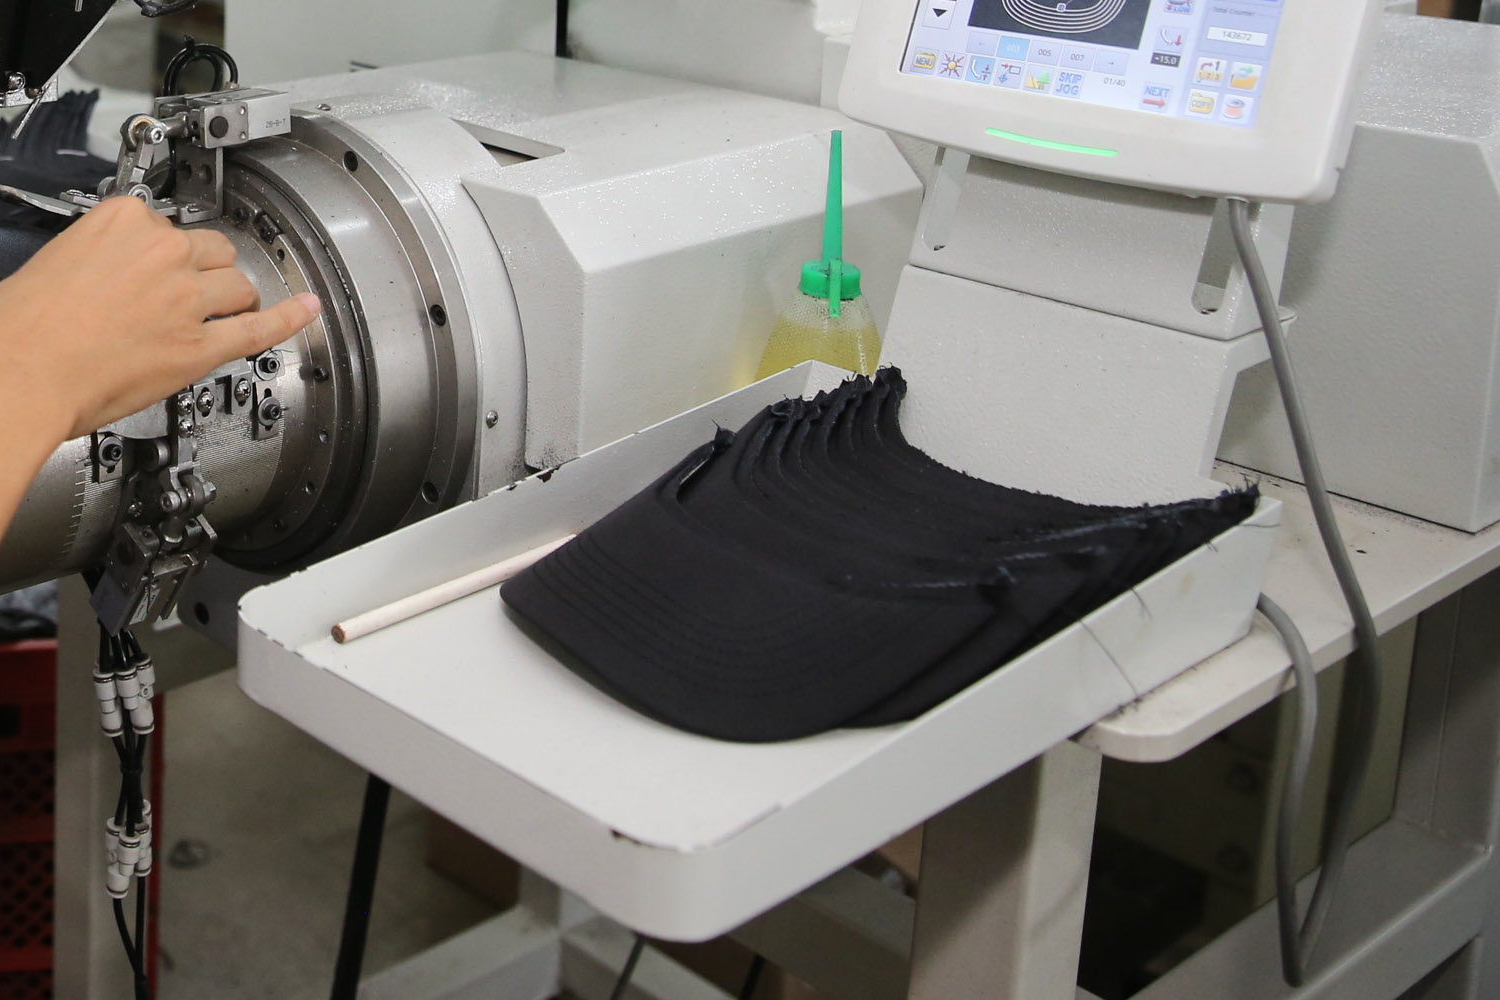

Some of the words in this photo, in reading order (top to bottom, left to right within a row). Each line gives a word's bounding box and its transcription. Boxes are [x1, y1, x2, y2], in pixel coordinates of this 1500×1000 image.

[1038, 48, 1052, 57] 005
[1070, 53, 1085, 62] 007
[915, 56, 933, 66] MENU
[1059, 71, 1083, 84] SKIP
[1103, 77, 1126, 87] 01/40
[1055, 84, 1079, 96] JOG
[1145, 85, 1170, 98] NEXT
